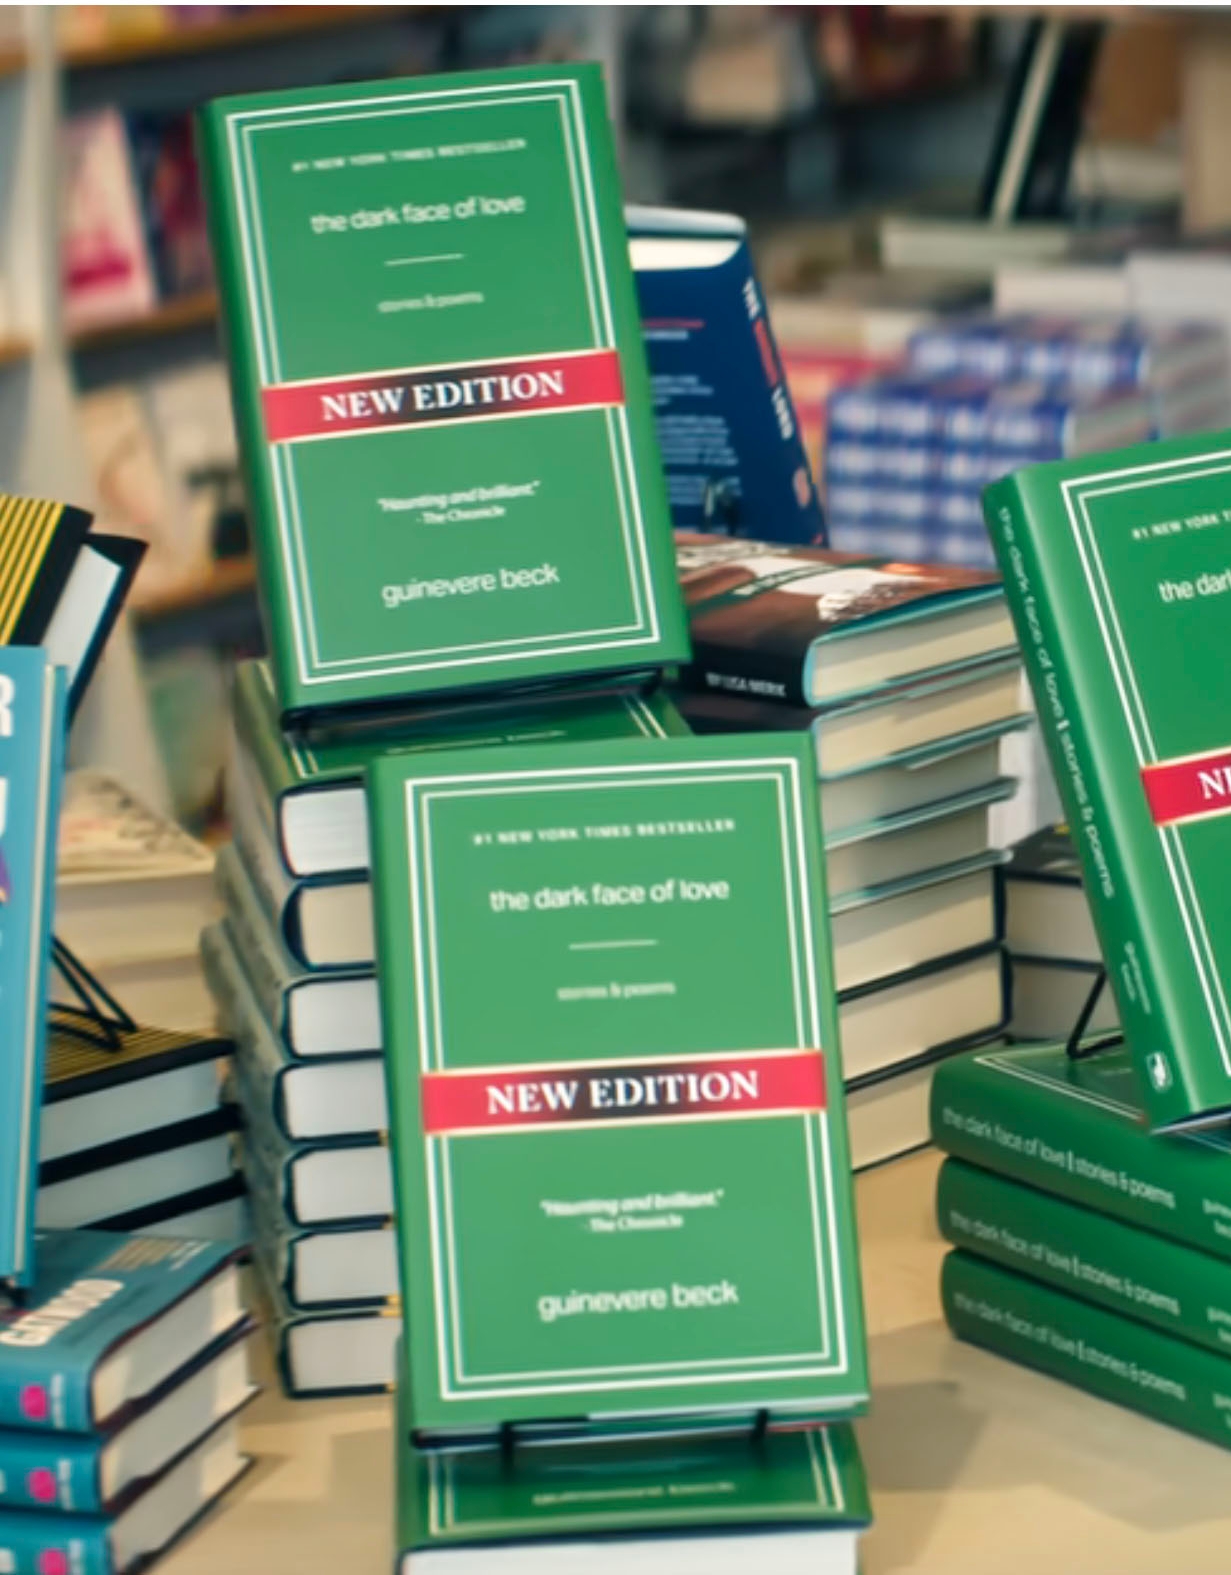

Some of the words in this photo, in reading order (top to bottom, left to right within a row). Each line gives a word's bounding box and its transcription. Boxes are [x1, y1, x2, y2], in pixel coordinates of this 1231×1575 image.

[310, 214, 347, 234] the
[351, 206, 399, 229] dark
[402, 203, 450, 223] face
[454, 197, 476, 218] of
[480, 196, 526, 214] love
[320, 387, 403, 421] NEW
[412, 370, 564, 411] EDITION
[1152, 521, 1182, 536] NEW
[1185, 513, 1219, 529] YORK
[382, 572, 496, 608] guinevere
[500, 563, 560, 589] beck
[1158, 580, 1194, 602] the
[498, 830, 532, 843] NEW
[538, 828, 578, 841] YORK
[585, 824, 631, 838] TIMES
[637, 819, 735, 837] BESTSELLER
[489, 891, 529, 912] the
[534, 886, 588, 909] dark
[592, 883, 644, 905] face
[650, 878, 674, 902] of
[680, 880, 729, 899] love
[486, 1081, 578, 1114] NEW
[589, 1070, 759, 1108] EDITION
[538, 1288, 666, 1322] guinevere
[672, 1280, 738, 1307] beck
